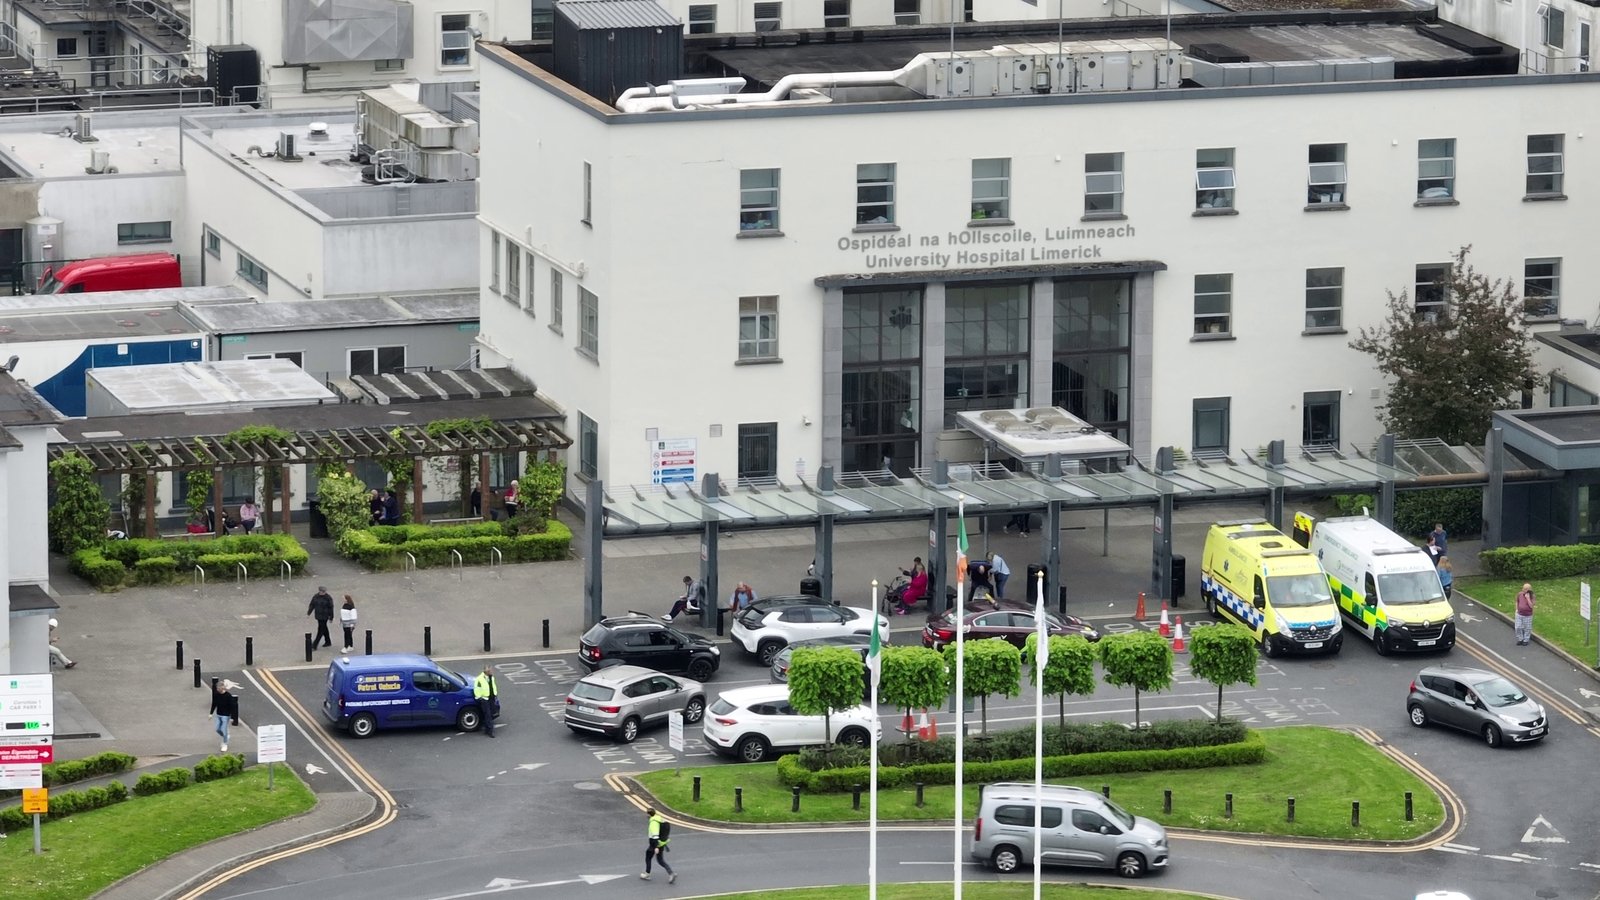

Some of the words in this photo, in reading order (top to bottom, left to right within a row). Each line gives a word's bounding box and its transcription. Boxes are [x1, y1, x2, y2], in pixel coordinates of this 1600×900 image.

[837, 233, 912, 252] Ospidéal
[919, 235, 940, 247] na
[1045, 224, 1136, 241] Luimneach
[865, 250, 951, 269] University
[956, 247, 1025, 266] Hospital
[1030, 244, 1102, 261] Limerick
[358, 683, 377, 691] Patrol
[379, 682, 401, 690] Vehicle
